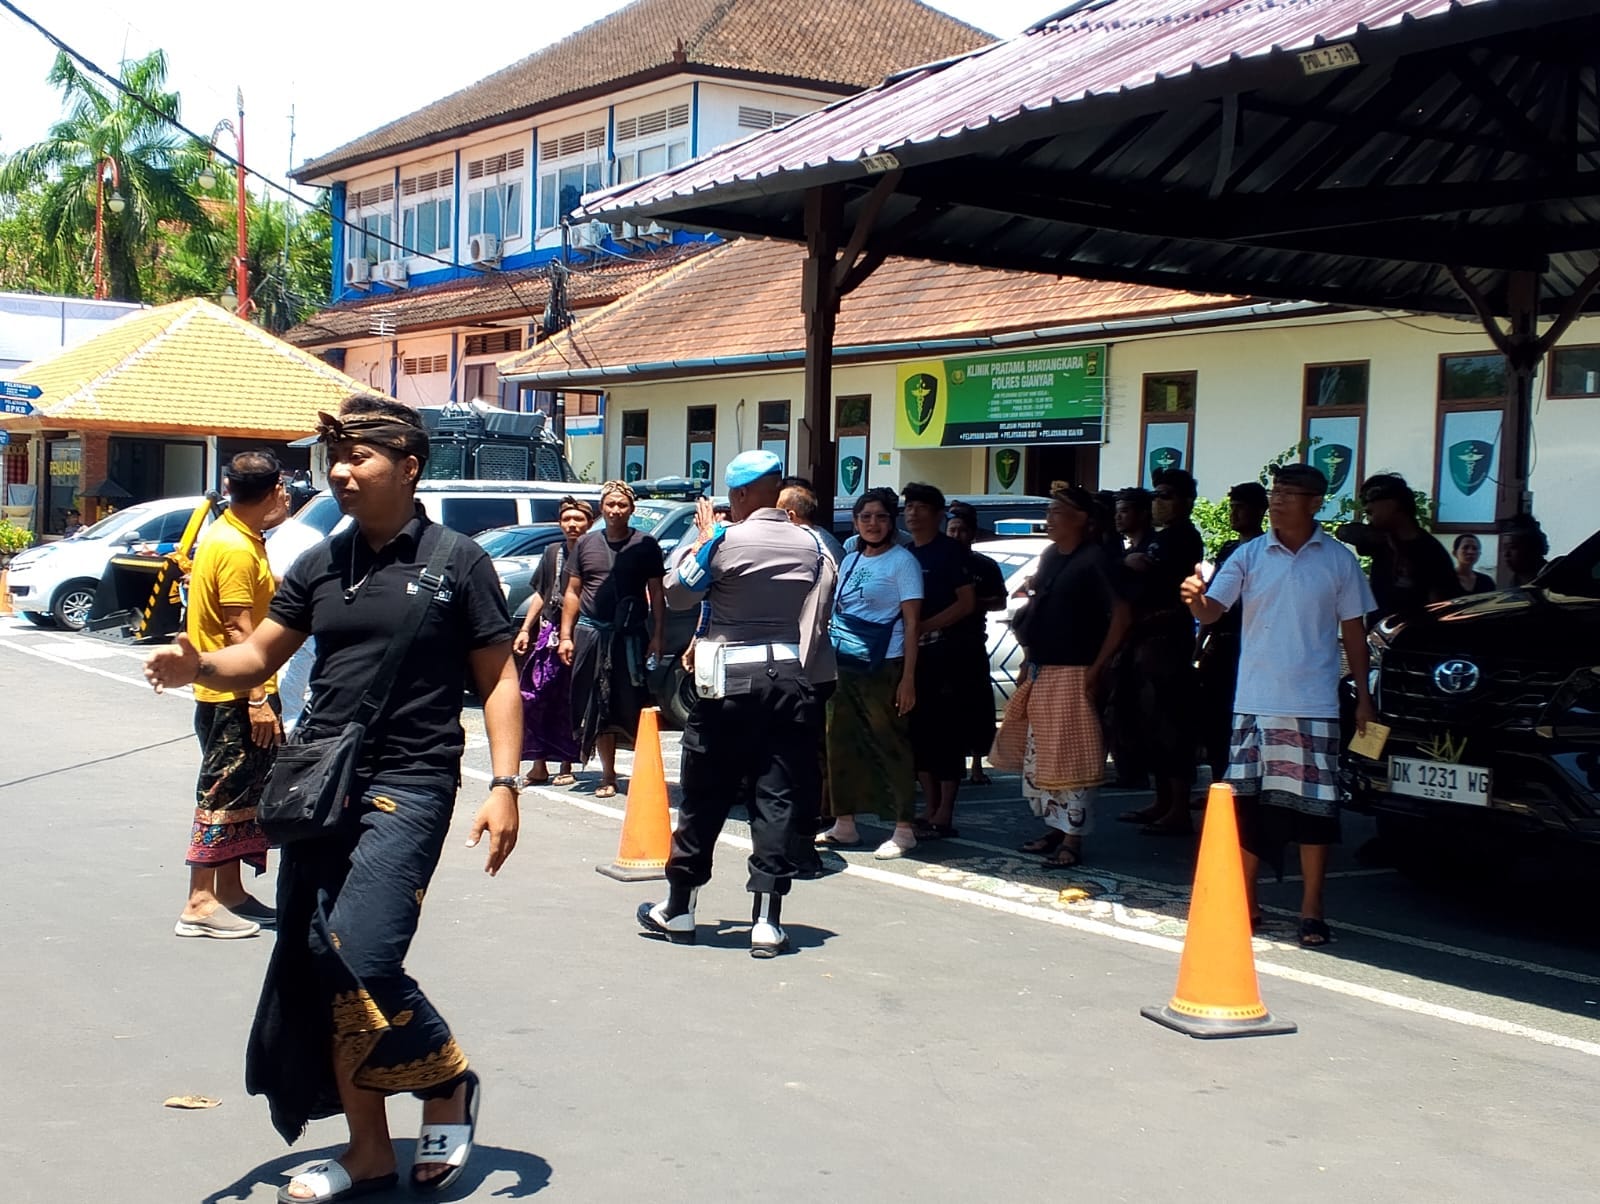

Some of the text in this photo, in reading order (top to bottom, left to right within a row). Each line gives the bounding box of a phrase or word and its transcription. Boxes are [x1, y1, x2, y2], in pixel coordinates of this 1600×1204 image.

[967, 357, 1084, 377] KLINIK PRATAMA BHAYANGKARA
[992, 373, 1054, 390] POLRES GIANYAR
[5, 405, 26, 414] BPKB
[1392, 761, 1489, 793] DK 1231 WG
